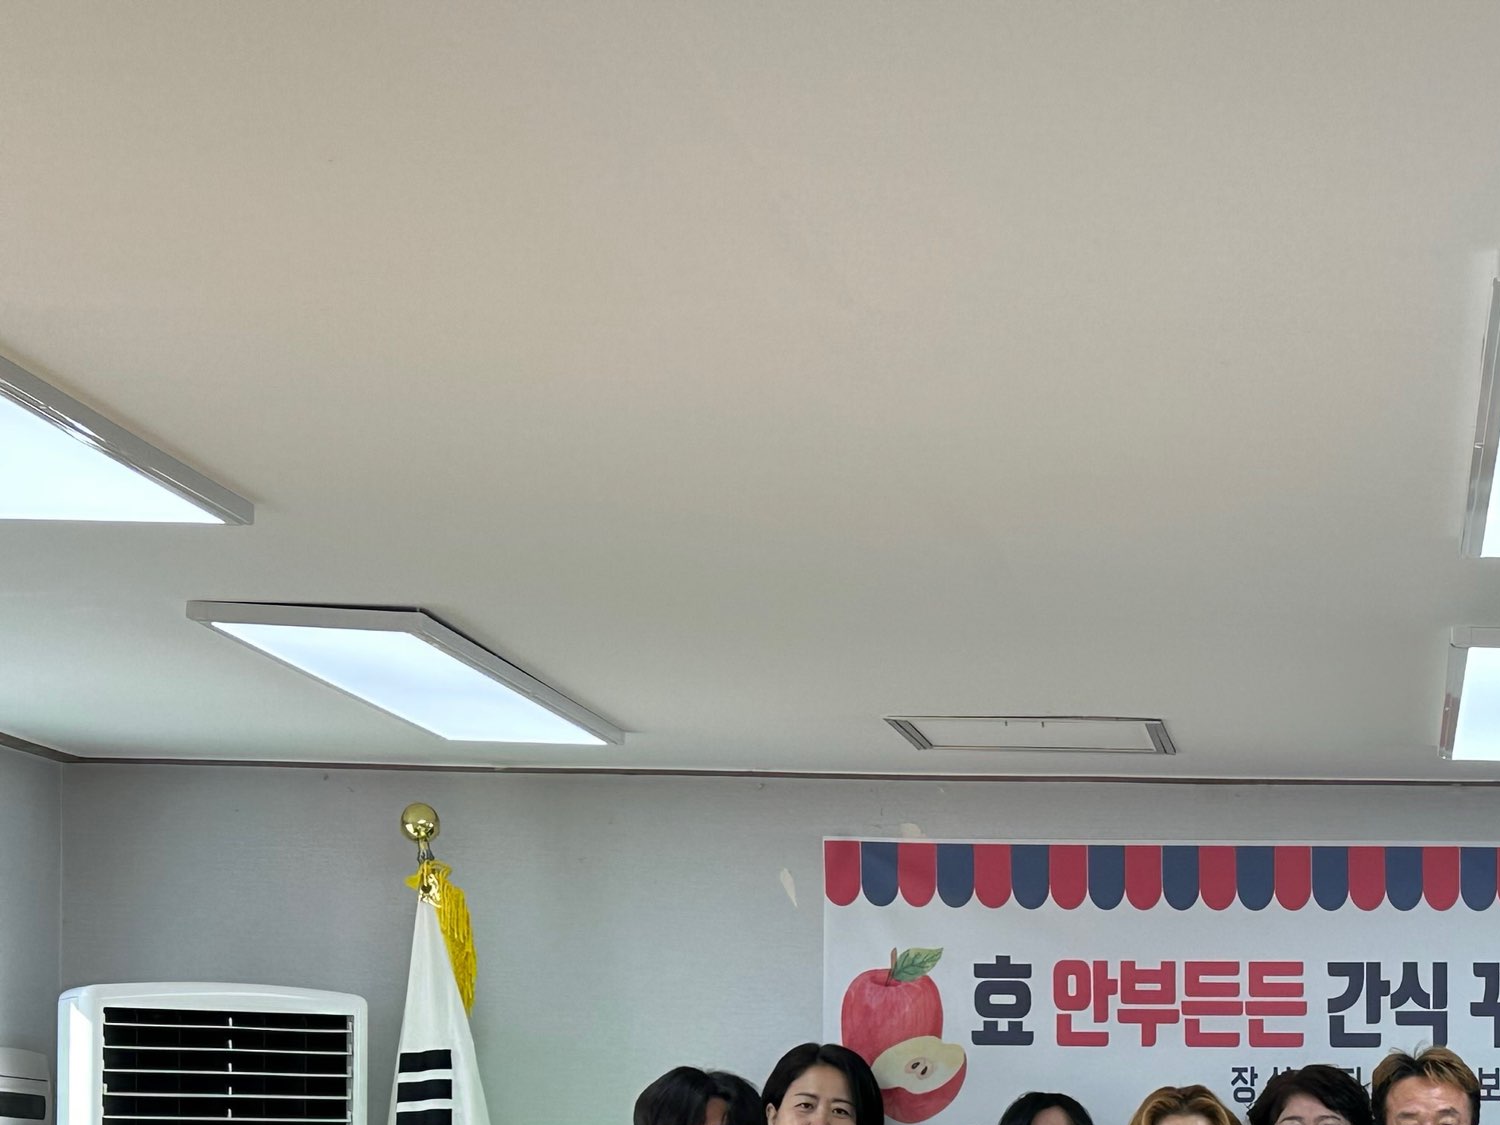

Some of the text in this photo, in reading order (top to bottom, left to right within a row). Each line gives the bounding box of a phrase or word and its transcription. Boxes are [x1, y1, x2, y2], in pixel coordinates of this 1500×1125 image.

[971, 955, 1034, 1046] 효
[1052, 959, 1307, 1048] 안부든든
[1327, 962, 1448, 1048] 간식
